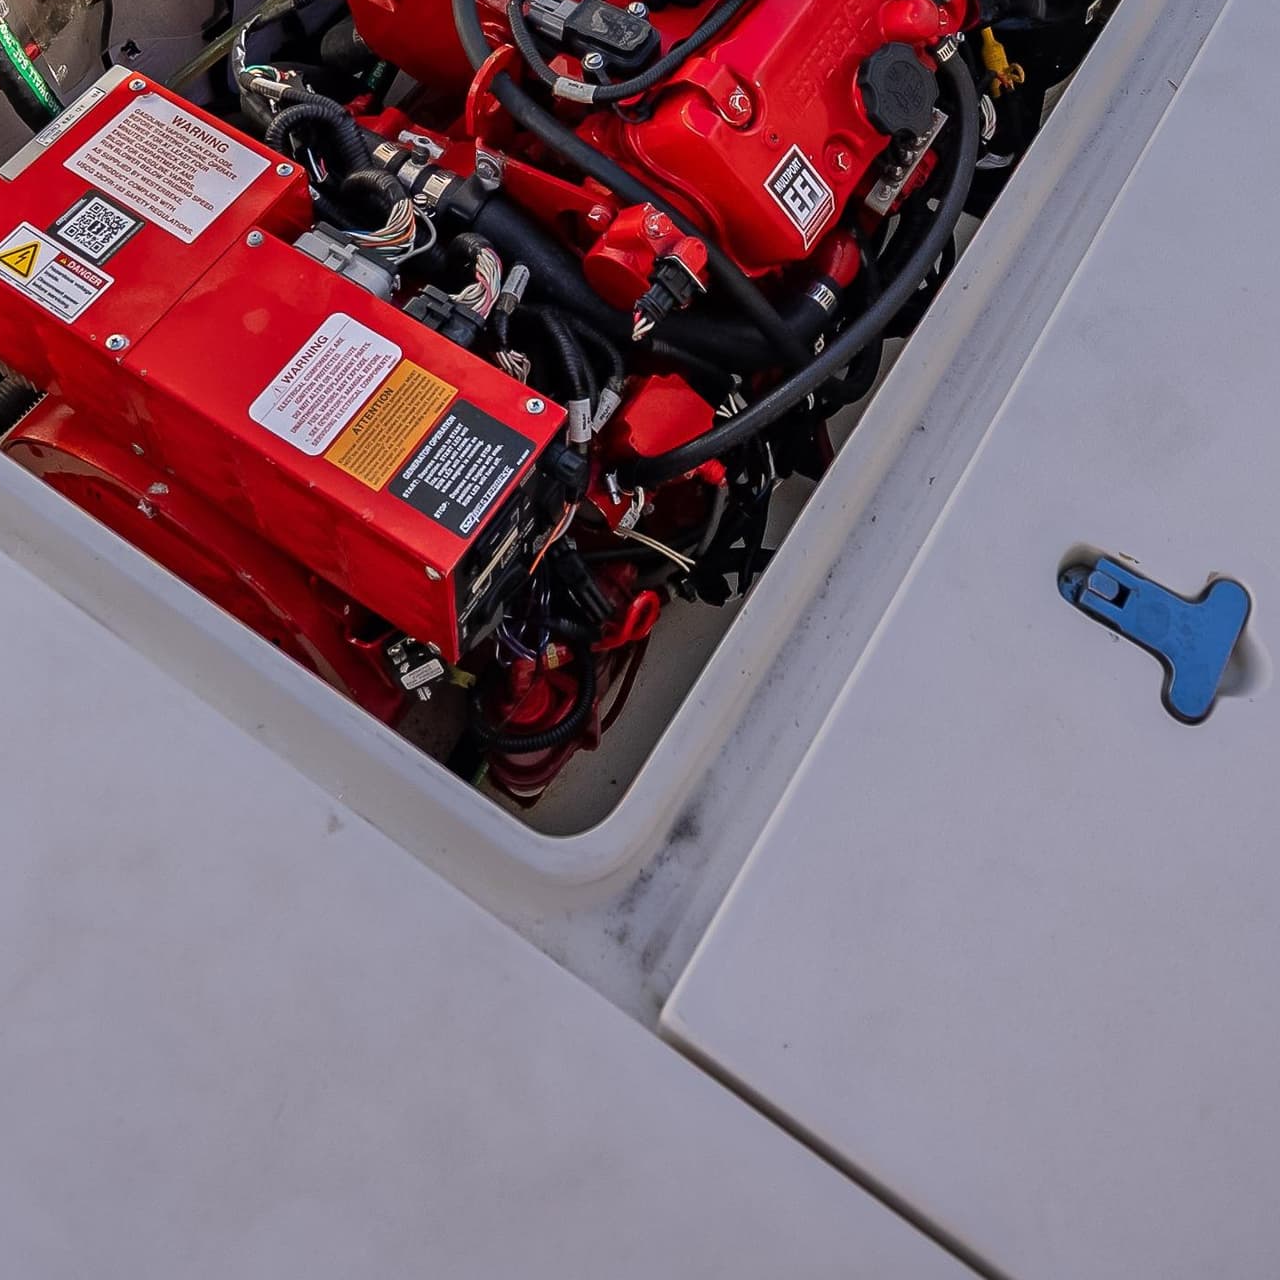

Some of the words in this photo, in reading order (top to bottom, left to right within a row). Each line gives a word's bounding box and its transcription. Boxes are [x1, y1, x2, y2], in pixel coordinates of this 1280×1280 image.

[29, 64, 60, 115] ARDWALL
[169, 115, 230, 153] WARNING
[188, 140, 204, 152] CAN
[91, 146, 102, 154] AS
[100, 151, 132, 172] SUPPLIED
[130, 169, 141, 178] BY
[142, 139, 157, 150] AND
[155, 147, 179, 163] CHECK
[177, 160, 197, 174] BOTH
[148, 133, 163, 144] FOR
[161, 141, 171, 149] AT
[169, 146, 191, 161] LEAST
[190, 158, 210, 172] FOUR
[152, 127, 184, 148] STARTING
[206, 160, 238, 180] OPERATE
[97, 161, 128, 182] PRODUCT
[126, 179, 160, 202] COMPLIES
[157, 199, 176, 212] WITH
[113, 147, 141, 166] BLOWER
[138, 163, 163, 179] BELOW
[161, 177, 192, 197] CRUISING
[179, 169, 195, 181] AND
[774, 157, 801, 194] MULTIPORT
[124, 190, 149, 207] SAFETY
[783, 168, 824, 223] EFI
[65, 260, 103, 286] DANGER
[276, 380, 306, 412] ELECTRICAL
[332, 337, 344, 348] ARE
[279, 333, 329, 385] WARNING
[336, 379, 349, 392] MAY
[350, 386, 394, 435] ATTENTION
[401, 444, 432, 480] GENERATOR
[428, 414, 456, 446] OPERATION
[451, 435, 462, 447] LED
[401, 477, 420, 498] START:
[442, 467, 453, 478] LED
[469, 484, 480, 495] LED
[433, 499, 450, 518] STOP:
